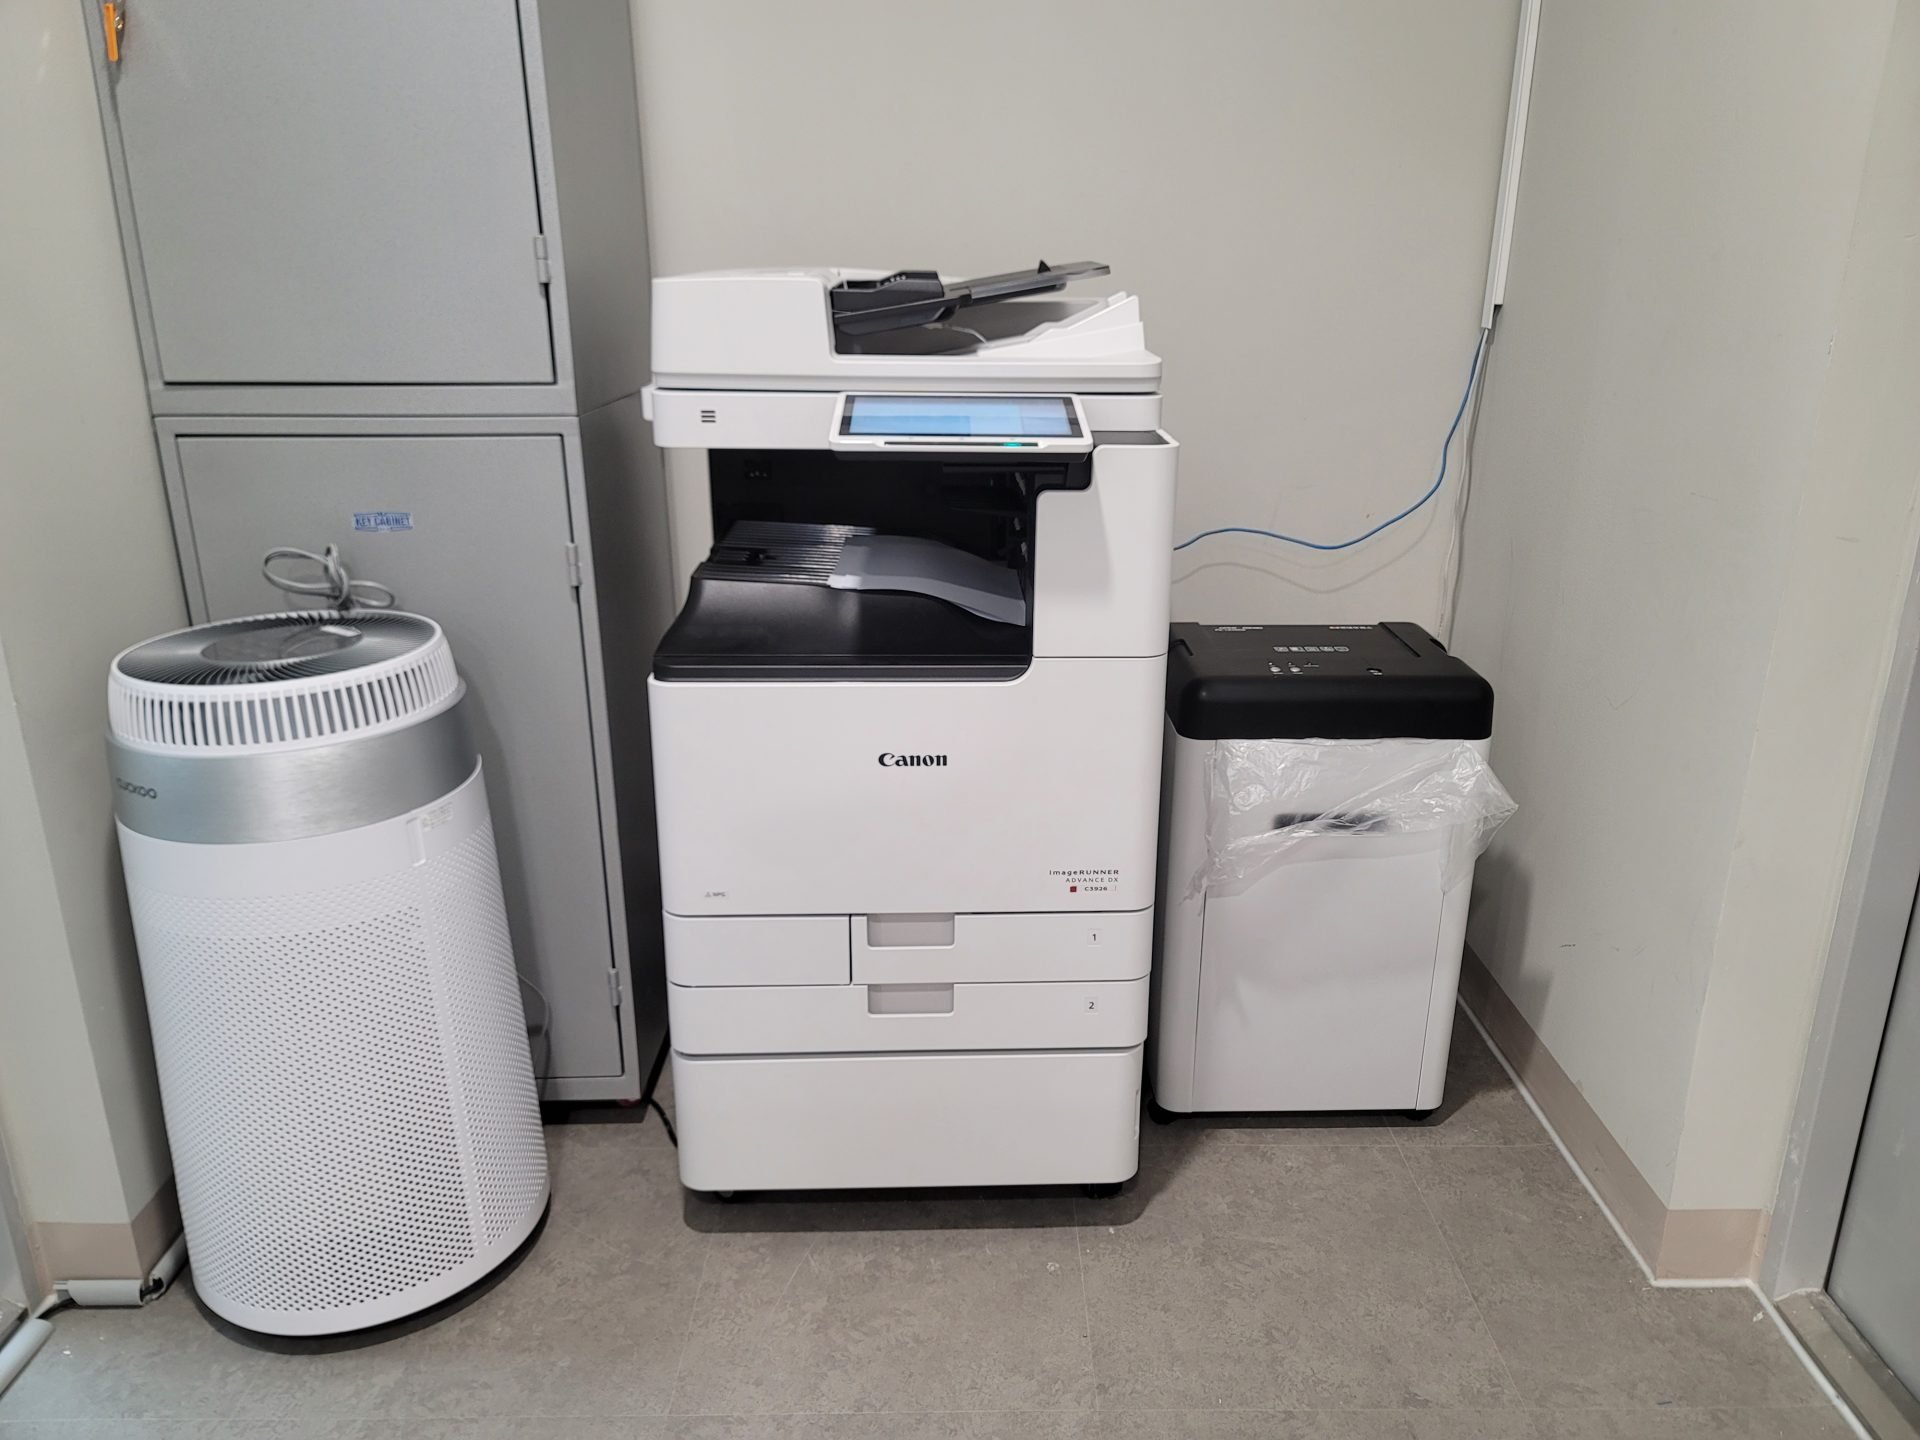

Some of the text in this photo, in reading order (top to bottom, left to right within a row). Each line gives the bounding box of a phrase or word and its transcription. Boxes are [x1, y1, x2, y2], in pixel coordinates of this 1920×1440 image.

[355, 516, 410, 527] KEY CABINET
[878, 752, 948, 767] Canon
[1092, 933, 1097, 942] 1
[1088, 1001, 1095, 1010] 2
